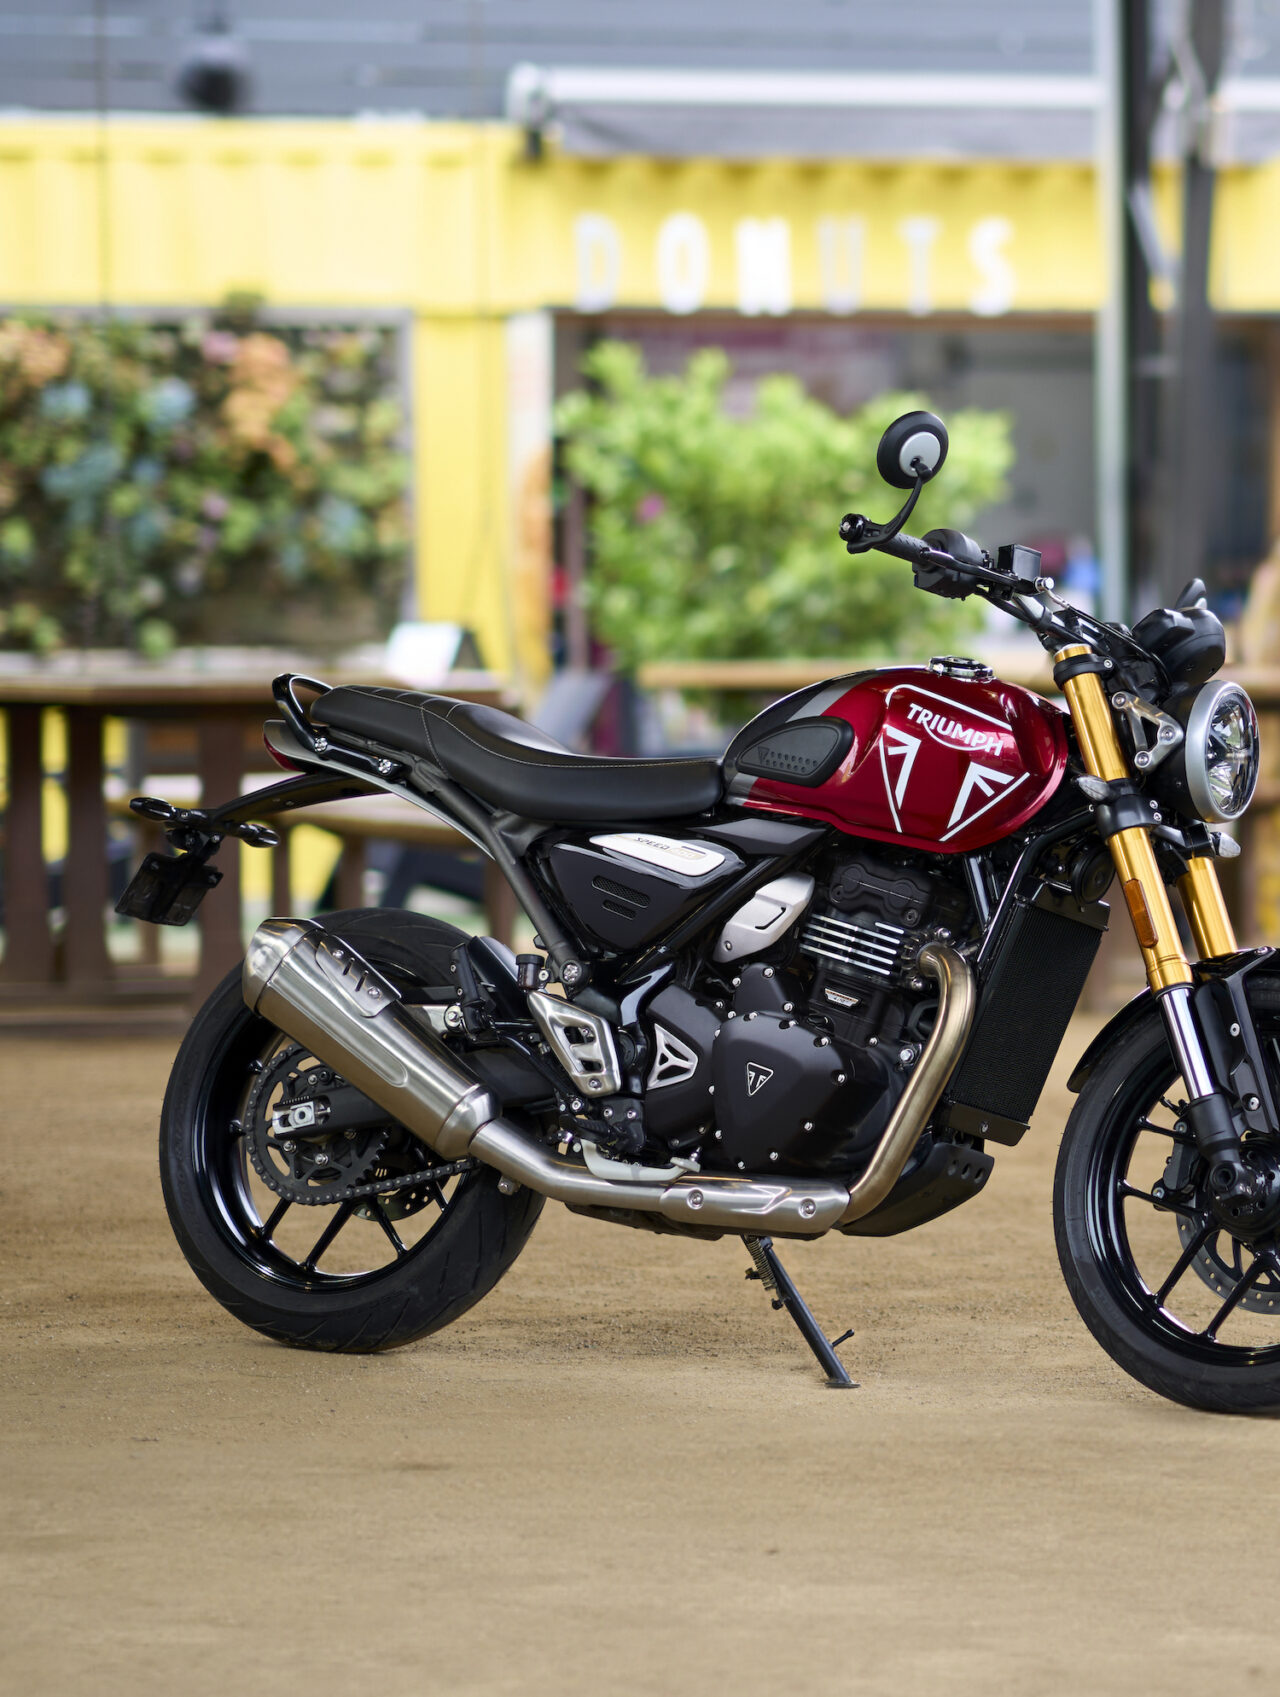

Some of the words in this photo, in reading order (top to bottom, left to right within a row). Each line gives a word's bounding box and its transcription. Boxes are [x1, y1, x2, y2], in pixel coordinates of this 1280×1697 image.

[573, 212, 1014, 316] DONUTS
[906, 702, 1004, 757] TRIUMPH
[635, 837, 671, 852] SPEED
